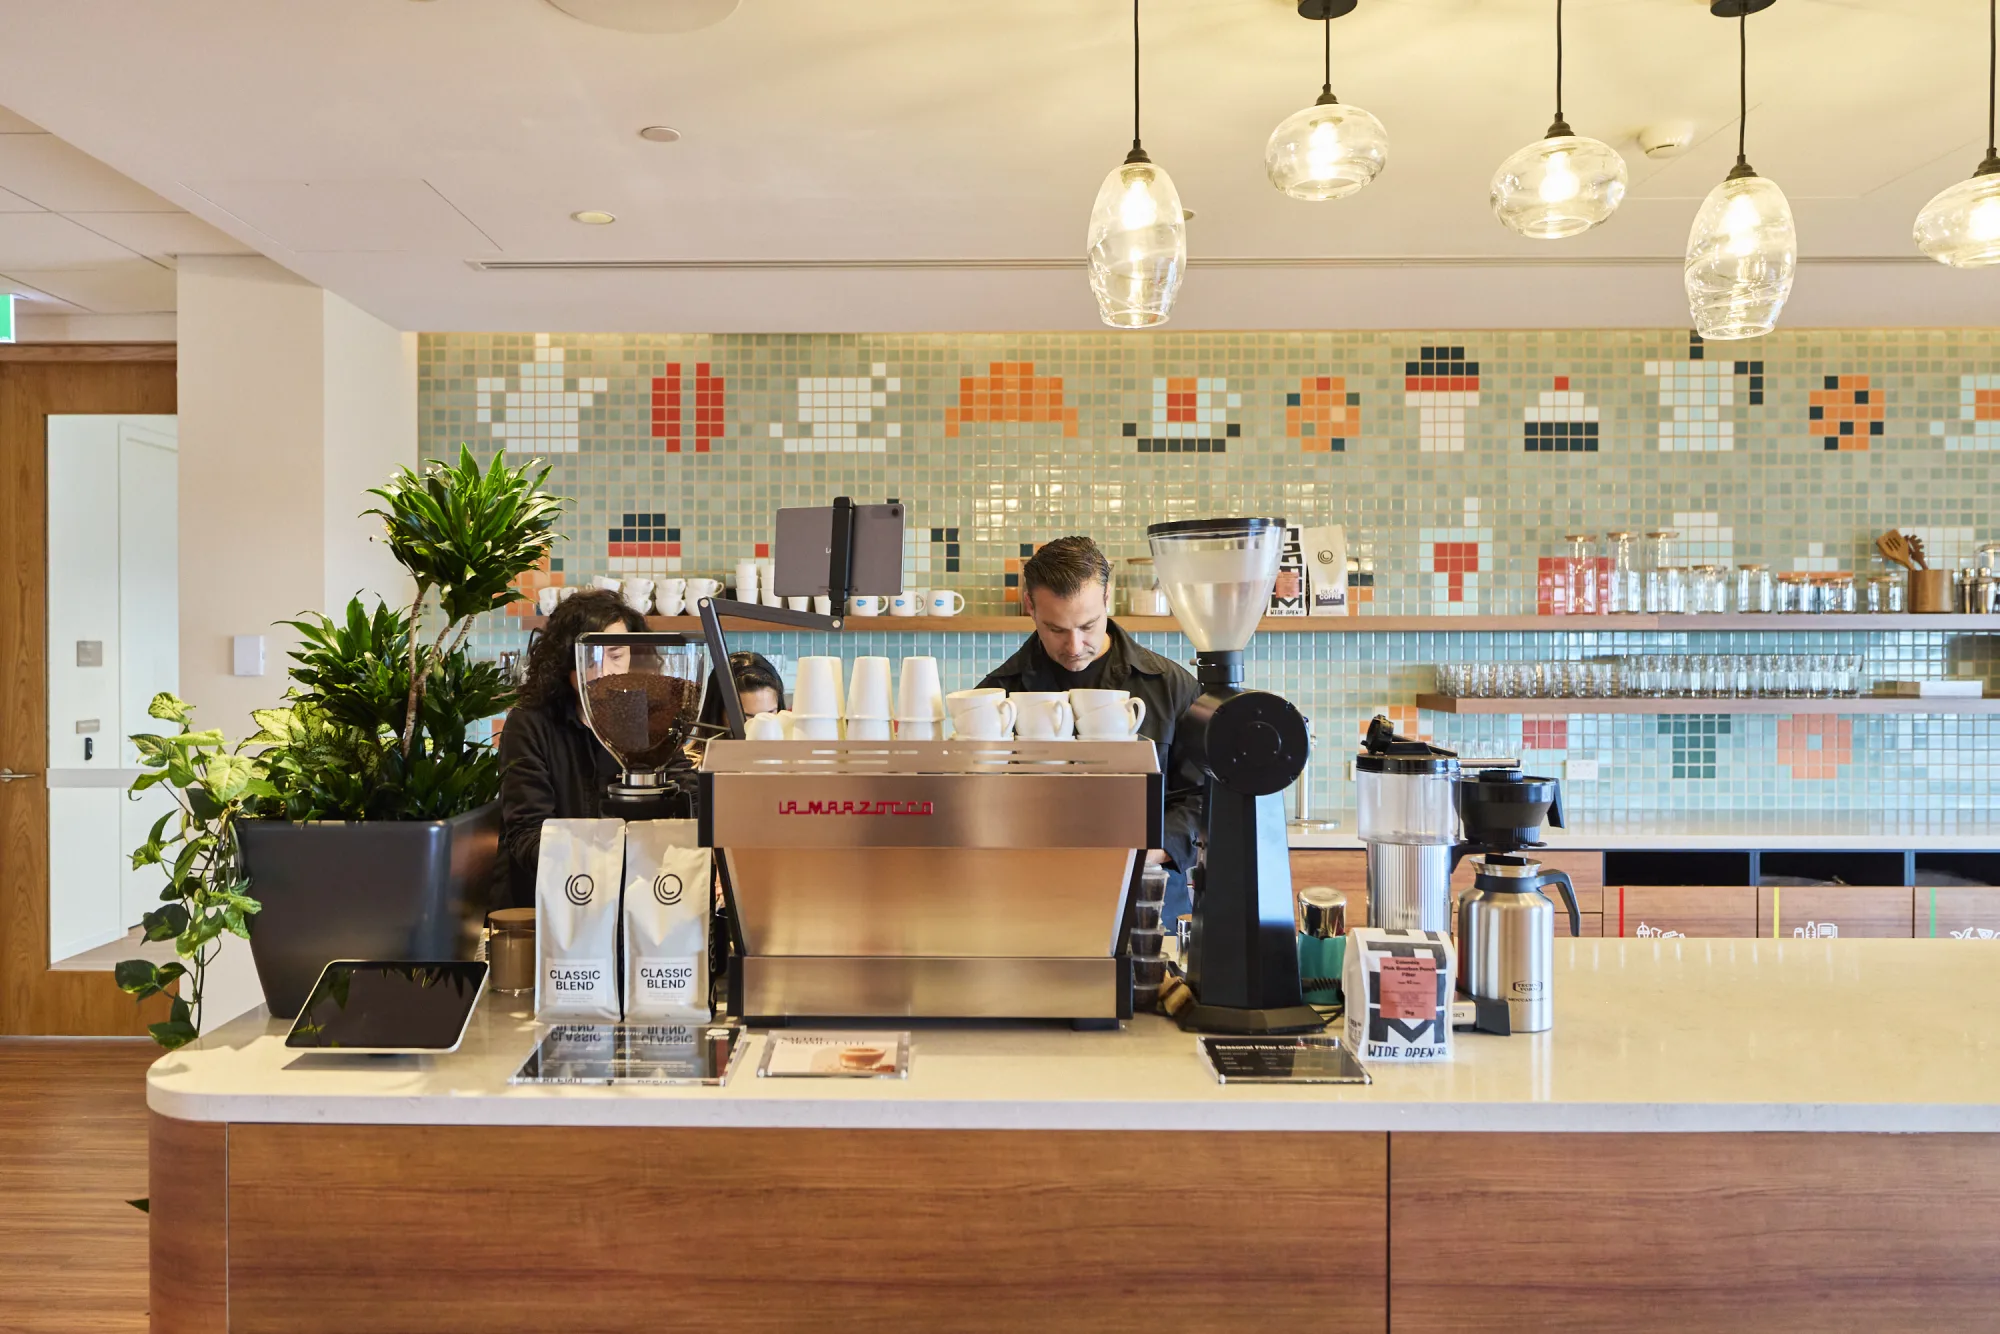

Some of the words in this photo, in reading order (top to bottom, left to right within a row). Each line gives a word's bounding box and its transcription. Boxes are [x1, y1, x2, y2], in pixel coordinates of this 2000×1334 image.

[549, 969, 601, 980] CLASSIC
[640, 967, 693, 978] CLASSIC
[555, 980, 595, 991] BLEND
[646, 979, 686, 989] BLEND
[1367, 1044, 1400, 1057] WIDE
[1404, 1047, 1435, 1058] OPEN
